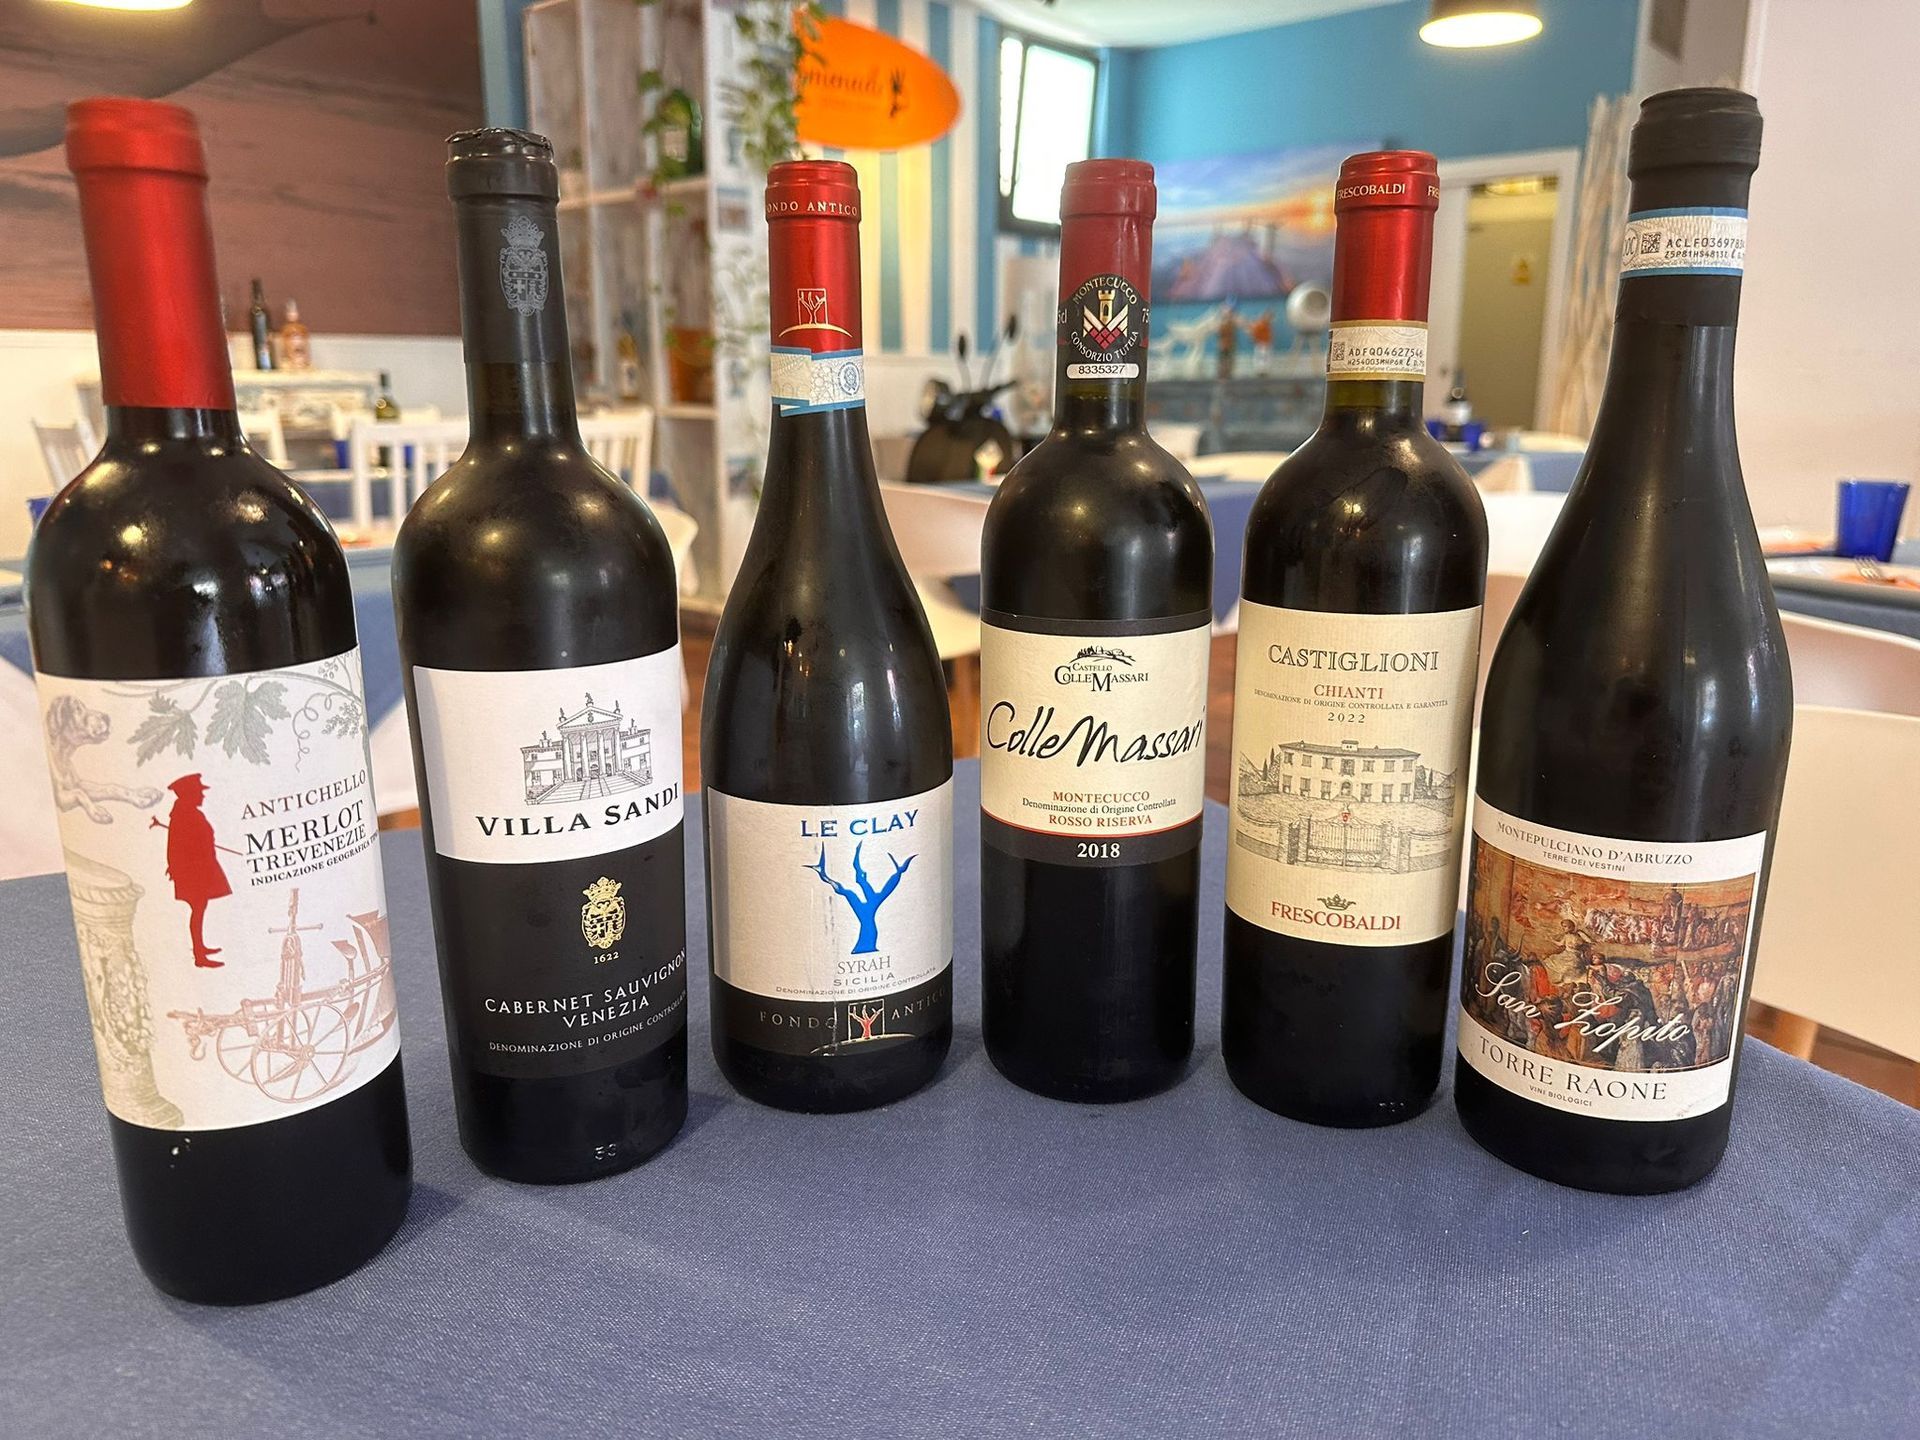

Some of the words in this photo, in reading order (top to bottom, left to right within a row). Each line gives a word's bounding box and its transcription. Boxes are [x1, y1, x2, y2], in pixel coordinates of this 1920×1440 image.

[1336, 184, 1406, 200] FRESCOBALDI
[807, 201, 858, 216] ANTICO
[1073, 277, 1138, 305] MONTECUCCO
[1070, 331, 1113, 362] CONSORZIO
[1114, 330, 1140, 360] TUTELA
[1078, 365, 1125, 375] 8335327
[1072, 662, 1113, 672] CASTELLO
[1268, 644, 1439, 672] CASTIGLIONI
[1254, 688, 1301, 704] DENOMINAZIONE
[1314, 699, 1345, 709] ORIGINE
[1348, 702, 1404, 710] CONTROLLATA
[1314, 684, 1384, 699] CHIANTI
[1328, 712, 1366, 723] 2022
[241, 768, 366, 820] ANTICHELLO
[1022, 797, 1087, 814] Denominazione
[1090, 804, 1099, 814] di
[1101, 804, 1135, 816] Origine
[1137, 797, 1177, 813] Controllata
[1053, 790, 1150, 804] MONTECUCCO
[476, 812, 591, 836] VILLA
[604, 782, 679, 826] SANDI
[1048, 814, 1093, 827] ROSSO
[1096, 814, 1153, 828] RISERVA
[244, 799, 363, 856] MERLOT
[801, 819, 838, 838] LE
[850, 809, 919, 836] CLAY
[246, 823, 367, 874] TREVENEZIE
[1077, 842, 1121, 859] 2018
[1498, 821, 1603, 857] MONTEPULCIANO
[1608, 849, 1693, 865] D'ABRUZZO
[251, 861, 324, 887] INDICAZIONE
[326, 839, 370, 867] GEOGRAFICA
[1543, 851, 1568, 863] TERRE
[1571, 857, 1586, 867] DEI
[1589, 861, 1626, 872] VESTINI
[1271, 901, 1401, 930] FRESCOBALDI
[594, 951, 620, 965] 1622
[837, 955, 891, 975] SYRAH
[485, 993, 594, 1015] CABERNET
[604, 947, 686, 1003] SAUVIGNON
[776, 986, 845, 996] DENOMINAZIONE
[858, 983, 891, 993] ORIGINE
[892, 967, 936, 987] CONTROLLATA
[833, 972, 896, 987] SICILIA
[1475, 962, 1541, 1019] San
[563, 995, 650, 1029] VENEZIA
[759, 1010, 838, 1030] FONDO
[891, 987, 945, 1022] ANTICO
[489, 1039, 584, 1053] DENOMINAZIONE
[588, 1036, 600, 1047] DI
[603, 1021, 645, 1042] ORIGINE
[1480, 1035, 1553, 1086] TORRE
[1566, 1073, 1668, 1101] RAONE
[1529, 1084, 1546, 1096] VINI
[1548, 1090, 1593, 1108] BIOLOGICI
